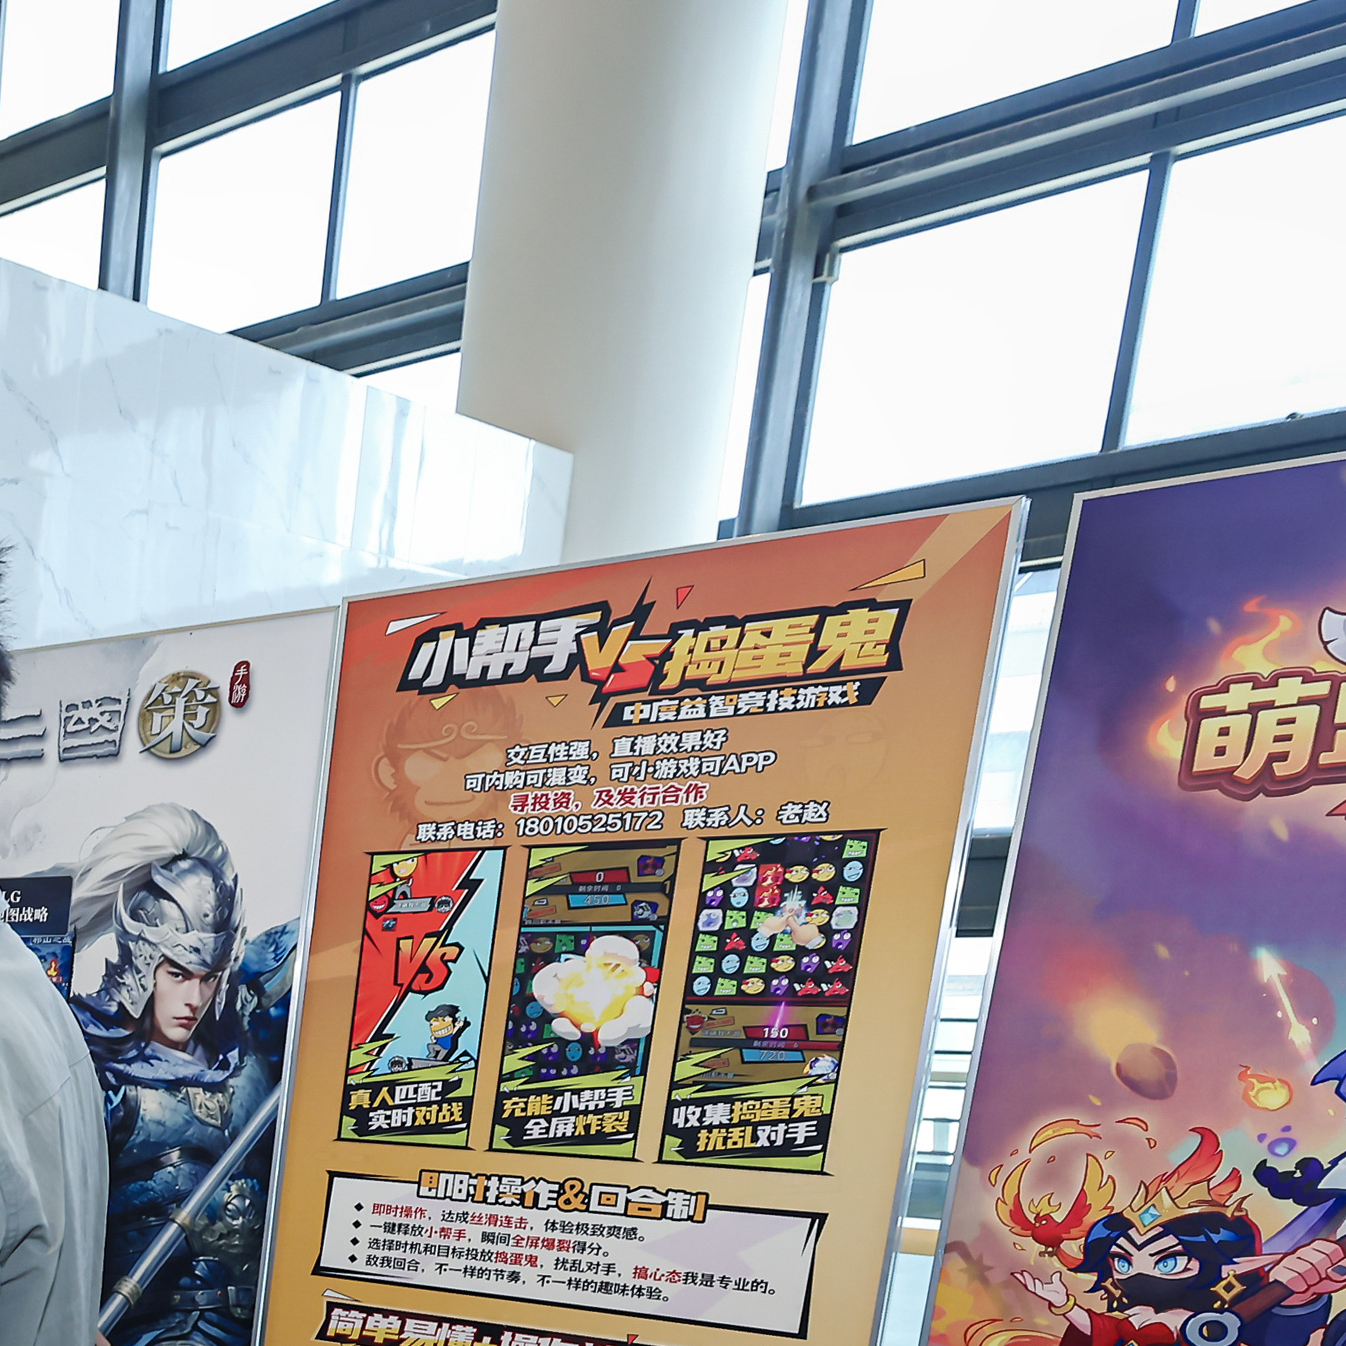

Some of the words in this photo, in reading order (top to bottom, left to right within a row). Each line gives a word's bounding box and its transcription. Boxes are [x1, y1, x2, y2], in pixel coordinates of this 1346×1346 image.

[407, 607, 900, 693] 小帮手VS捣蛋鬼
[231, 664, 249, 704] 手游
[622, 681, 861, 723] 中度益智竞技游戏
[507, 729, 727, 766] 交互性强，直播效果好
[465, 751, 776, 792] 可内购可混变，可小游戏可APP
[509, 782, 708, 814] 寻投资，及发行合作
[0, 906, 48, 923] 图战略
[396, 936, 462, 992] VS
[349, 1081, 443, 1110] 真人匹配
[501, 1085, 634, 1118] 充能小帮手
[672, 1094, 823, 1129] 收集捣蛋鬼
[368, 1101, 463, 1130] 实时对战
[522, 1110, 630, 1140] 全屏炸裂
[696, 1120, 818, 1152] 扰乱对手
[421, 1172, 706, 1221] 即时操作&回合制
[370, 1221, 609, 1257] 一键释放小帮手，瞬间全屏爆裂得分。
[372, 1203, 645, 1242] 即时操作，达成丝滑连击，体验极致爽感。
